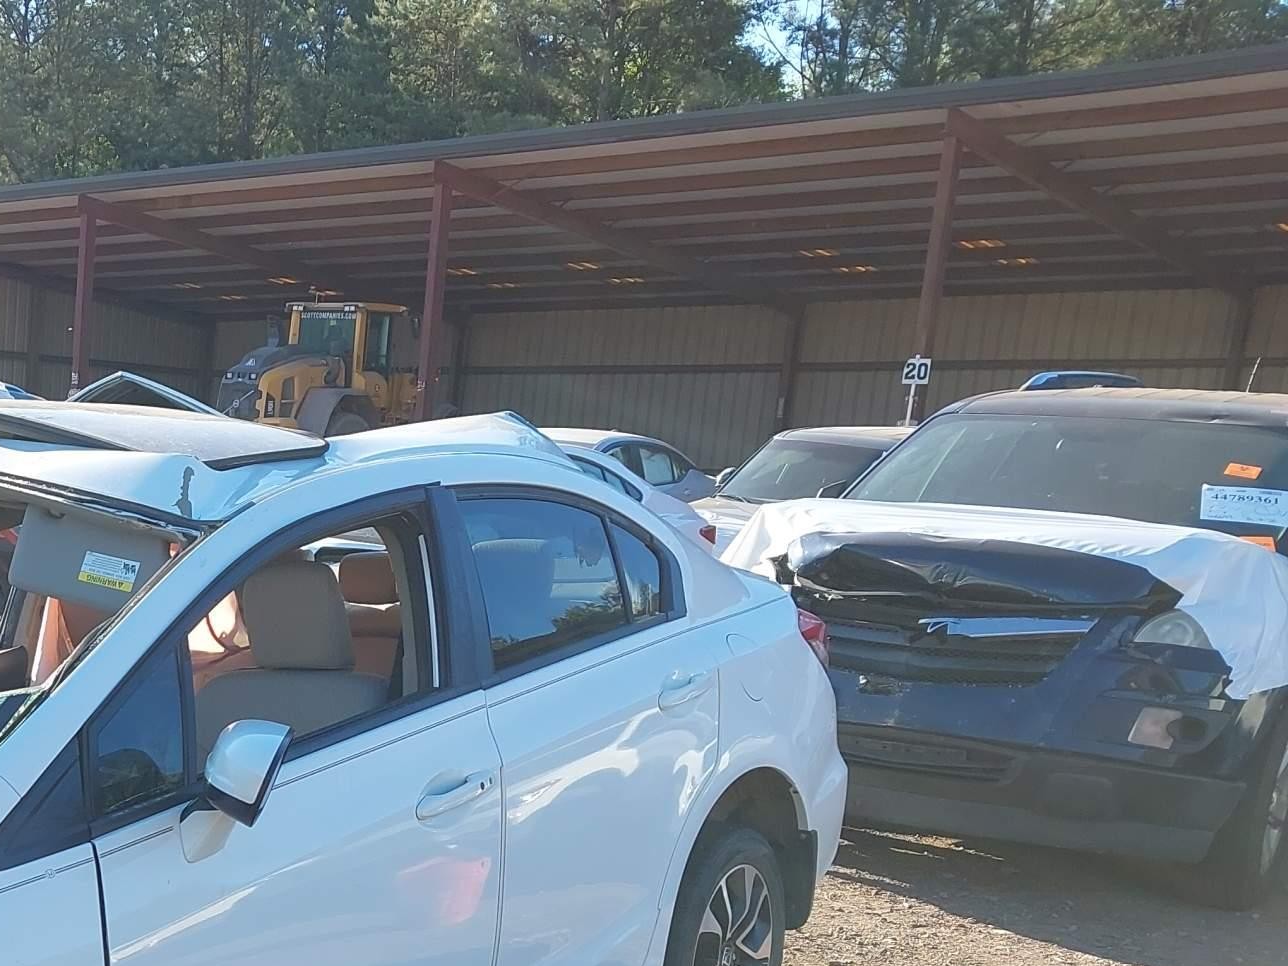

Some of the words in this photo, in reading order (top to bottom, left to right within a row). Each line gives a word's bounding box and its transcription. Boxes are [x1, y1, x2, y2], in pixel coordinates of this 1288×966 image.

[301, 311, 357, 320] SCOTTCOMPANIES.COM
[904, 362, 929, 380] 20
[1211, 493, 1279, 505] 44789361
